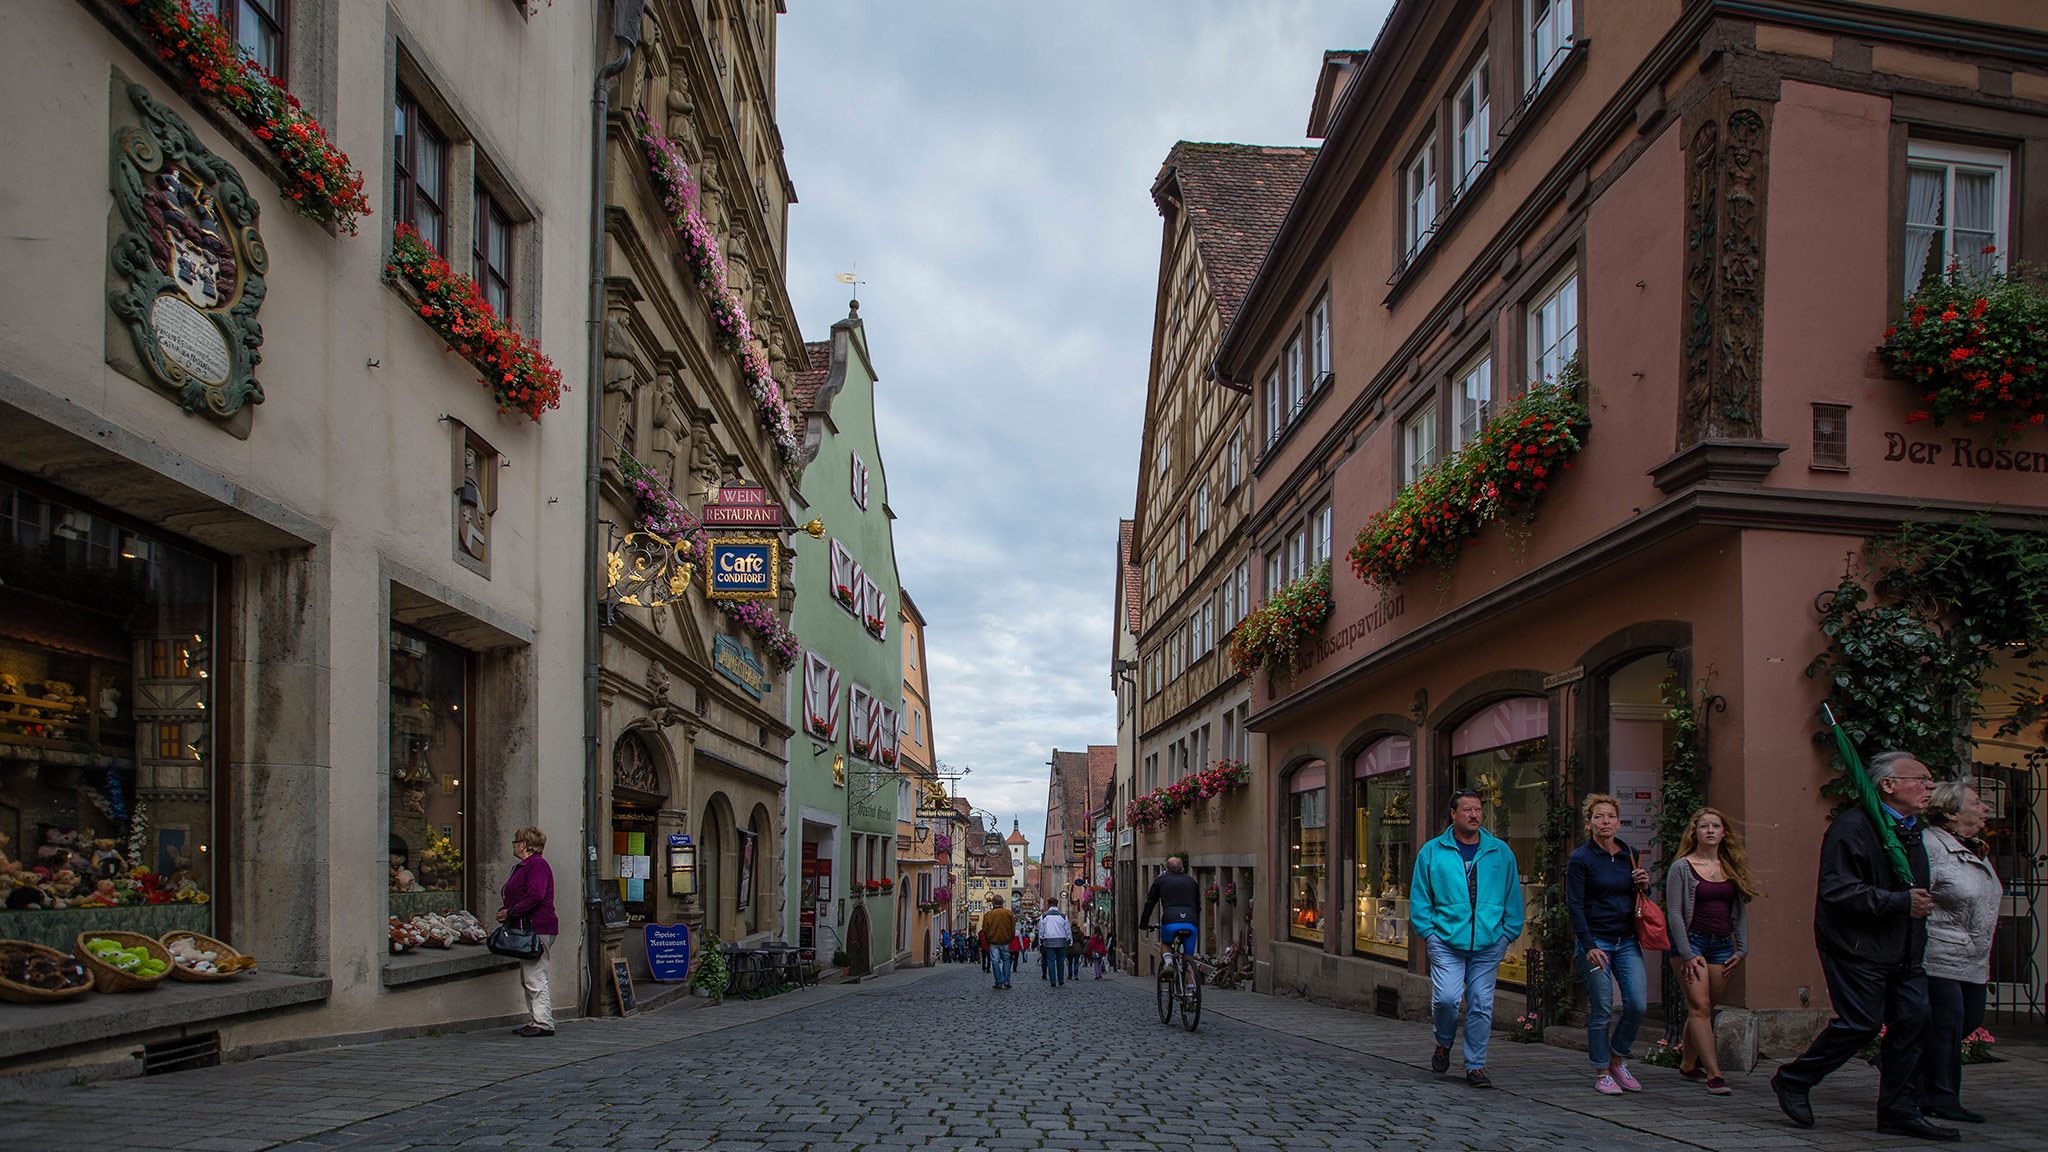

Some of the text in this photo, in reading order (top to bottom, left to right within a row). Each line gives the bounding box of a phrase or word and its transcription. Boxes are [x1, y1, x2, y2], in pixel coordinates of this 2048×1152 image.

[1884, 432, 2048, 473] Der Rosen
[723, 490, 761, 503] WEIN
[706, 508, 779, 521] RESTAURANT
[717, 573, 766, 583] CONDITOREI
[1296, 593, 1405, 675] Der Rosenpavillon
[654, 931, 680, 939] Speise-
[650, 939, 687, 947] Restaurant
